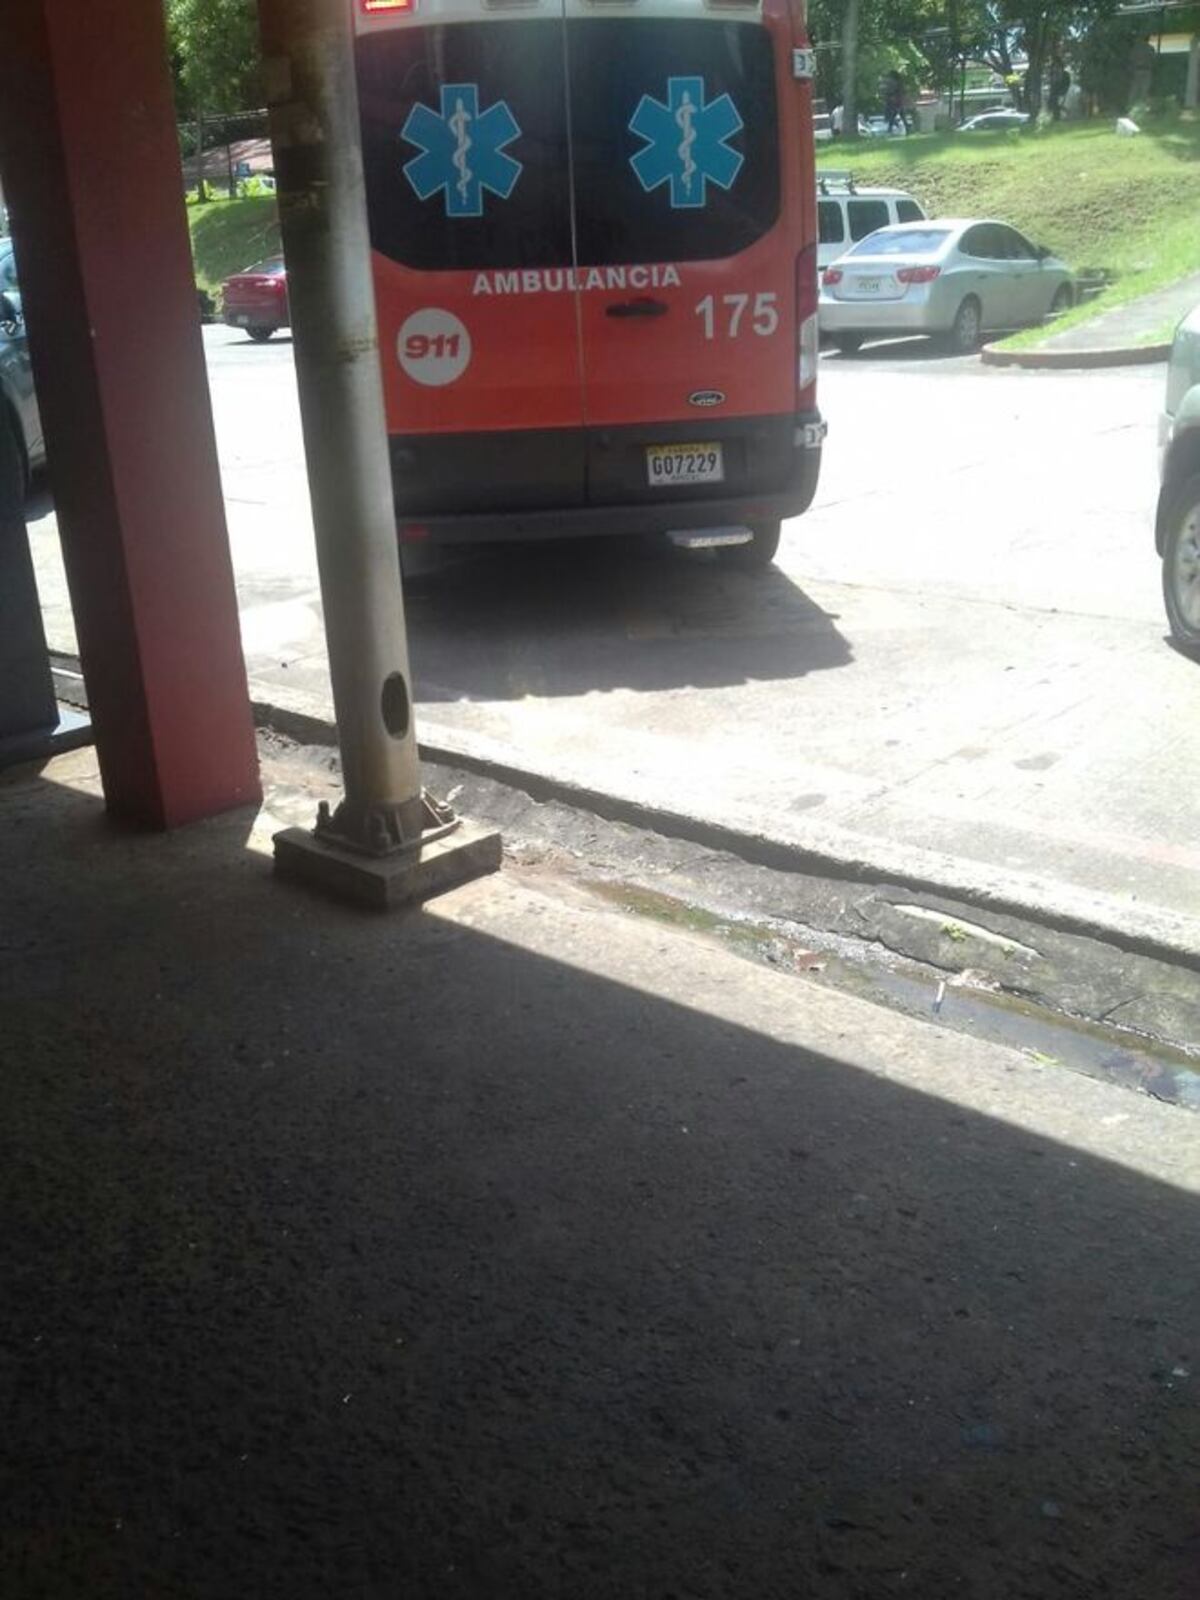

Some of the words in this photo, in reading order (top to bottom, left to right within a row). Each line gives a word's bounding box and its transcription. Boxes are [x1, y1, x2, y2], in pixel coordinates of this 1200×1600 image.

[472, 264, 681, 295] AMBULANCIA
[695, 292, 779, 339] 175
[405, 333, 460, 359] 911
